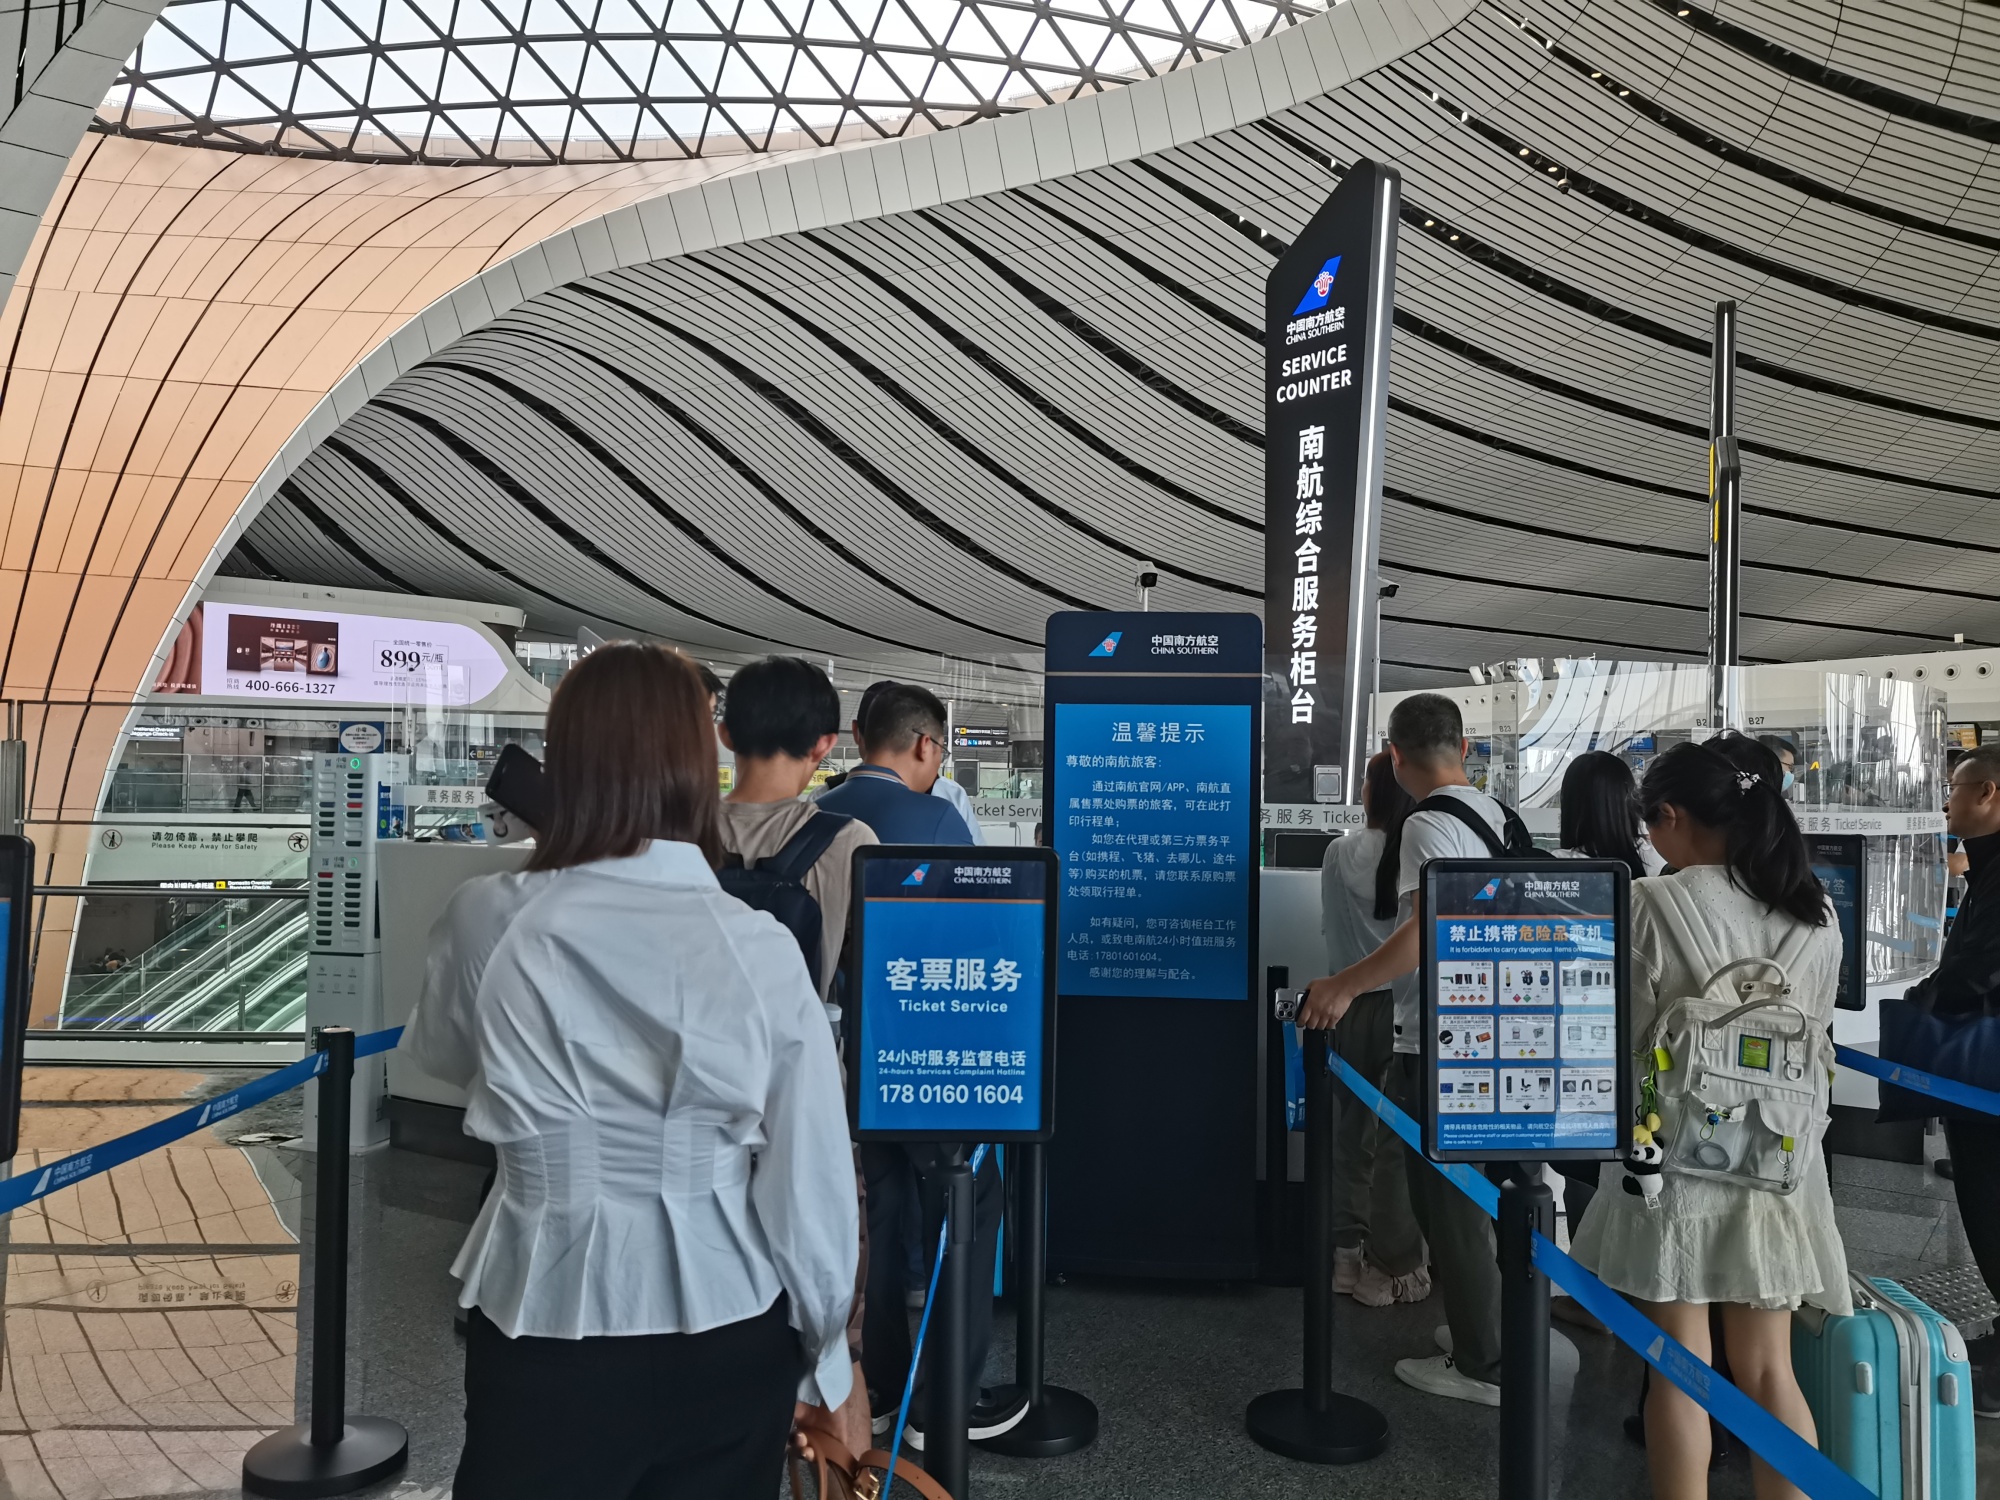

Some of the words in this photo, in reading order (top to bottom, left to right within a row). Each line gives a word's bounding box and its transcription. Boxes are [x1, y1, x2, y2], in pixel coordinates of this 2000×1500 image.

[1286, 306, 1345, 335] 中国南方航空
[1286, 331, 1306, 345] CHINA
[1308, 321, 1344, 339] SOUTHERN
[1282, 344, 1348, 377] SERVICE
[1276, 369, 1352, 403] COUNTER
[1290, 425, 1326, 724] 南航综合服务柜台
[1151, 634, 1218, 647] 中国南方航空
[1151, 647, 1175, 655] CHINA
[1177, 647, 1218, 655] SOUTHERN
[381, 650, 420, 670] 899
[245, 680, 335, 694] 400-666-1327
[1696, 718, 1707, 726] B2
[1112, 721, 1206, 744] 温馨提示
[1092, 780, 1231, 794] 通过南航官网/APP、南航直
[427, 790, 475, 804] 票务服务
[973, 803, 1005, 816] icket
[1069, 798, 1231, 812] 属售票处购票的旅客，可在此打
[1069, 815, 1120, 828] 印行程单；
[1260, 808, 1313, 825] 务服务
[1323, 811, 1365, 823] Ticket
[1799, 817, 1831, 832] 务服务
[1835, 818, 1858, 830] Ticket
[1858, 818, 1882, 830] Service
[152, 832, 258, 843] 请勿倚靠，禁止攀爬
[1092, 833, 1231, 847] 如您在代理或第三方票务平
[954, 866, 1011, 877] 中国南方航空
[1068, 886, 1143, 898] 处领取行程单。
[1525, 880, 1580, 891] 中国南方航空
[1090, 916, 1237, 931] 如有疑问，您可咨询柜台工作
[1450, 924, 1603, 942] 禁止携带危险品乘机
[1067, 933, 1237, 948] 人员，或致电南航24小时值班服务
[1518, 946, 1552, 955] dangerous
[886, 958, 1022, 992] 客票服务
[1089, 967, 1196, 980] 感谢您的理解与配合。
[899, 999, 945, 1012] Ticket
[950, 1000, 1008, 1013] Service
[878, 1050, 1026, 1067] 24小时服务监督电话
[954, 1068, 994, 1076] Complaint
[879, 1084, 914, 1104] 178
[919, 1084, 968, 1104] 0160
[974, 1084, 1023, 1104] 1604
